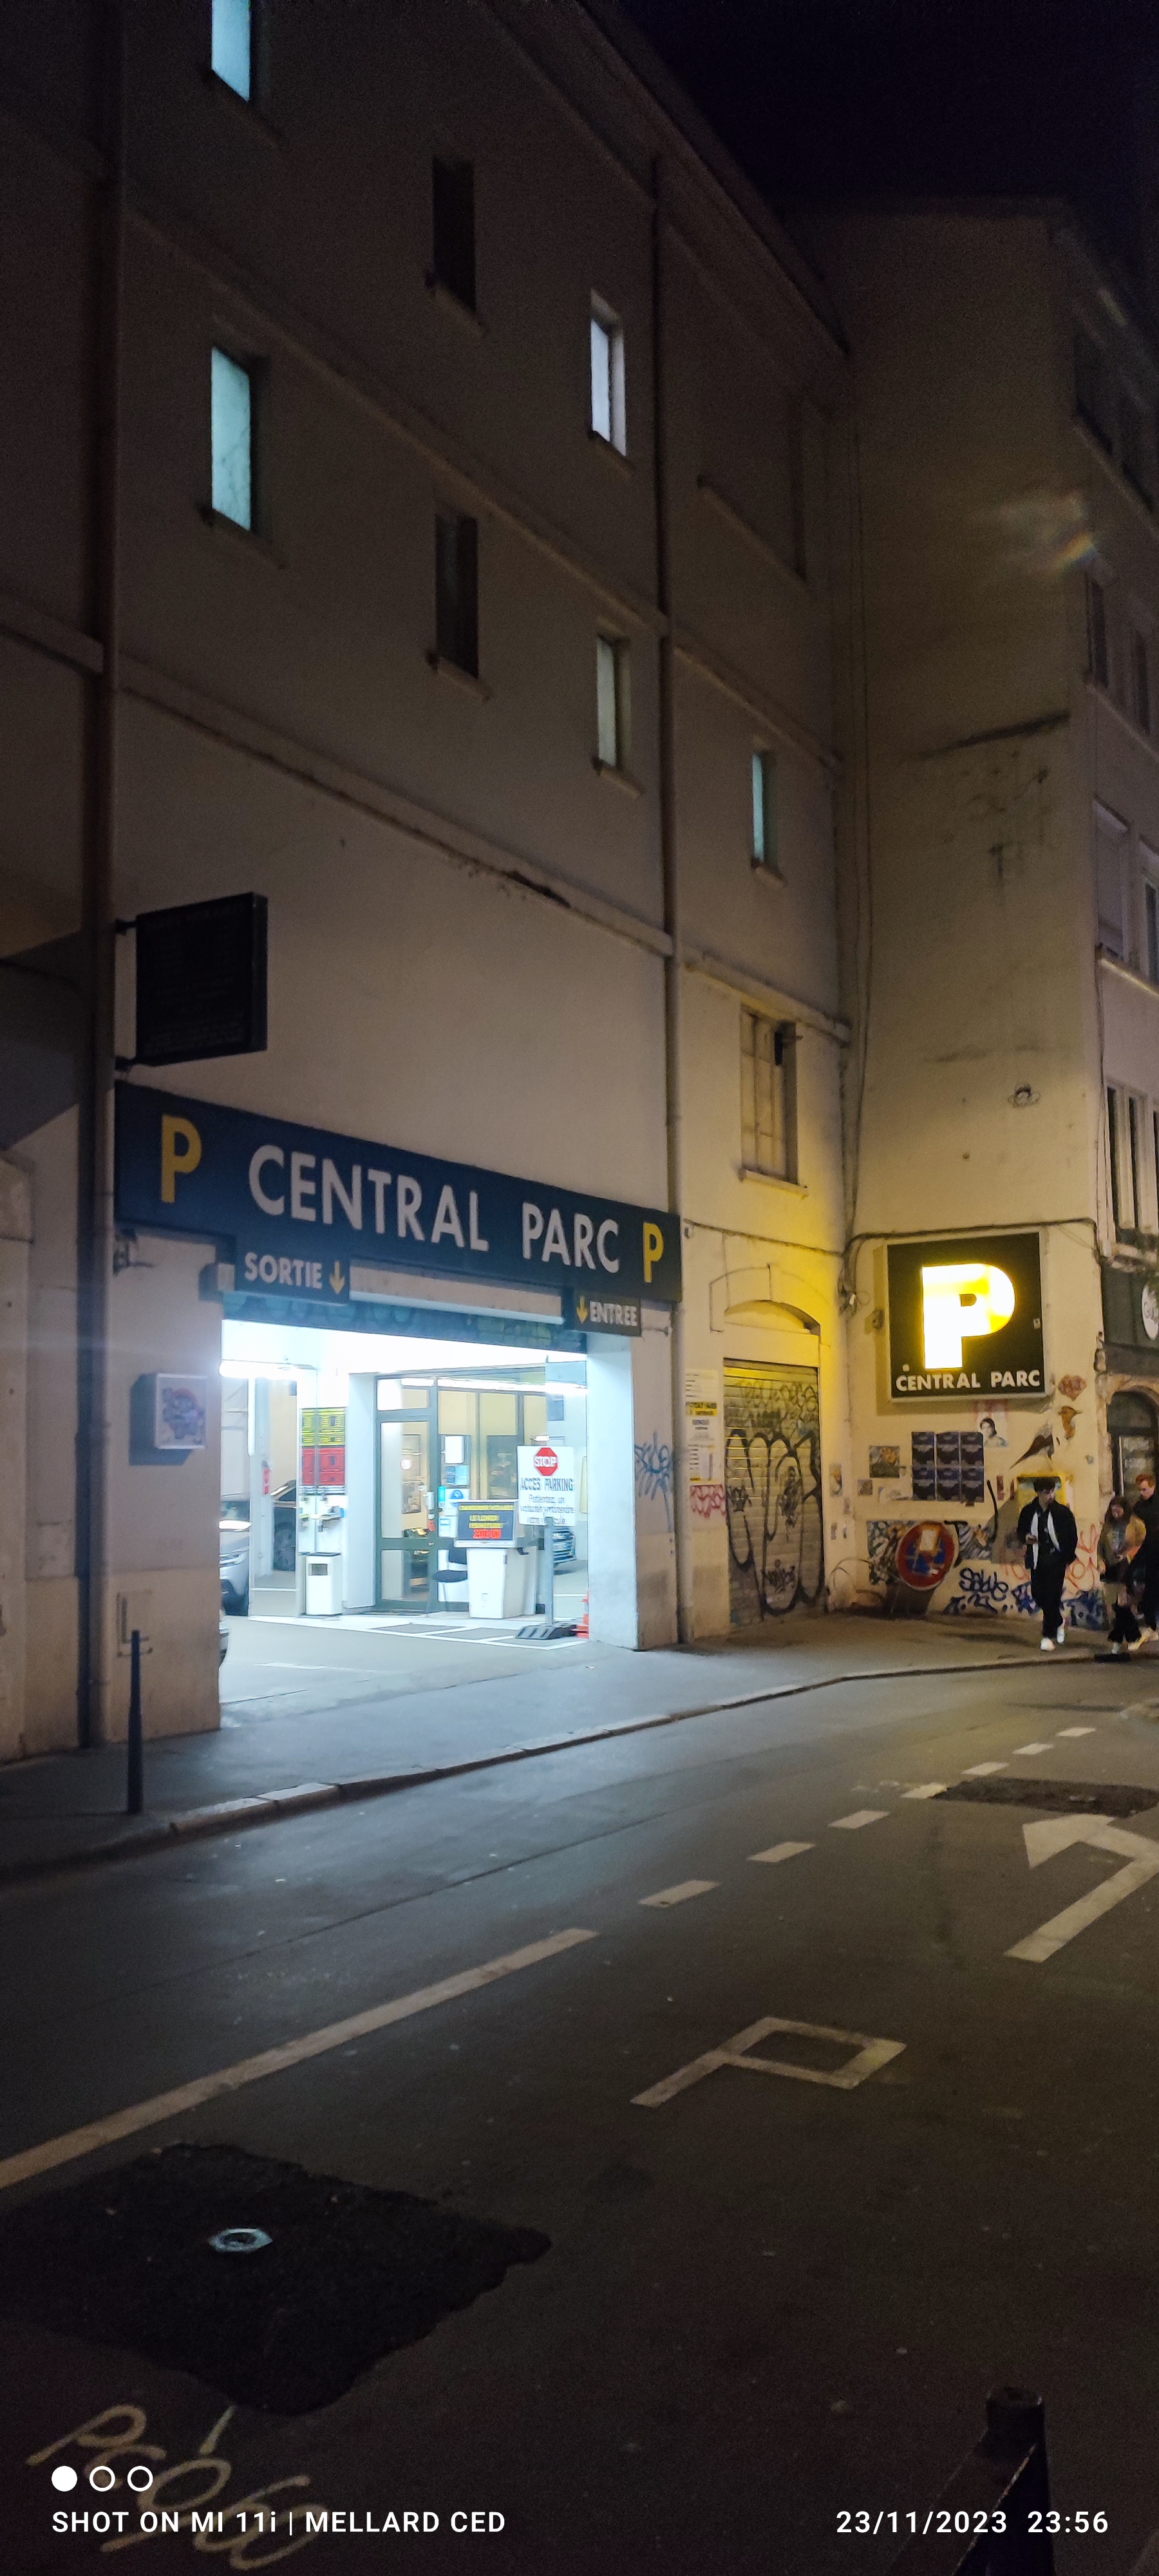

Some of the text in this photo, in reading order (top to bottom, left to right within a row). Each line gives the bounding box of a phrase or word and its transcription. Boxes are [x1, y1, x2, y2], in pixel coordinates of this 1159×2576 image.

[161, 1116, 664, 1283] P CENTRAL PARC P
[245, 1251, 323, 1289] SORTIE
[921, 1263, 1016, 1369] P
[896, 1370, 1041, 1391] CENTRAL PARC
[534, 1455, 558, 1468] STOP
[520, 1477, 574, 1492] ACCES PARKING
